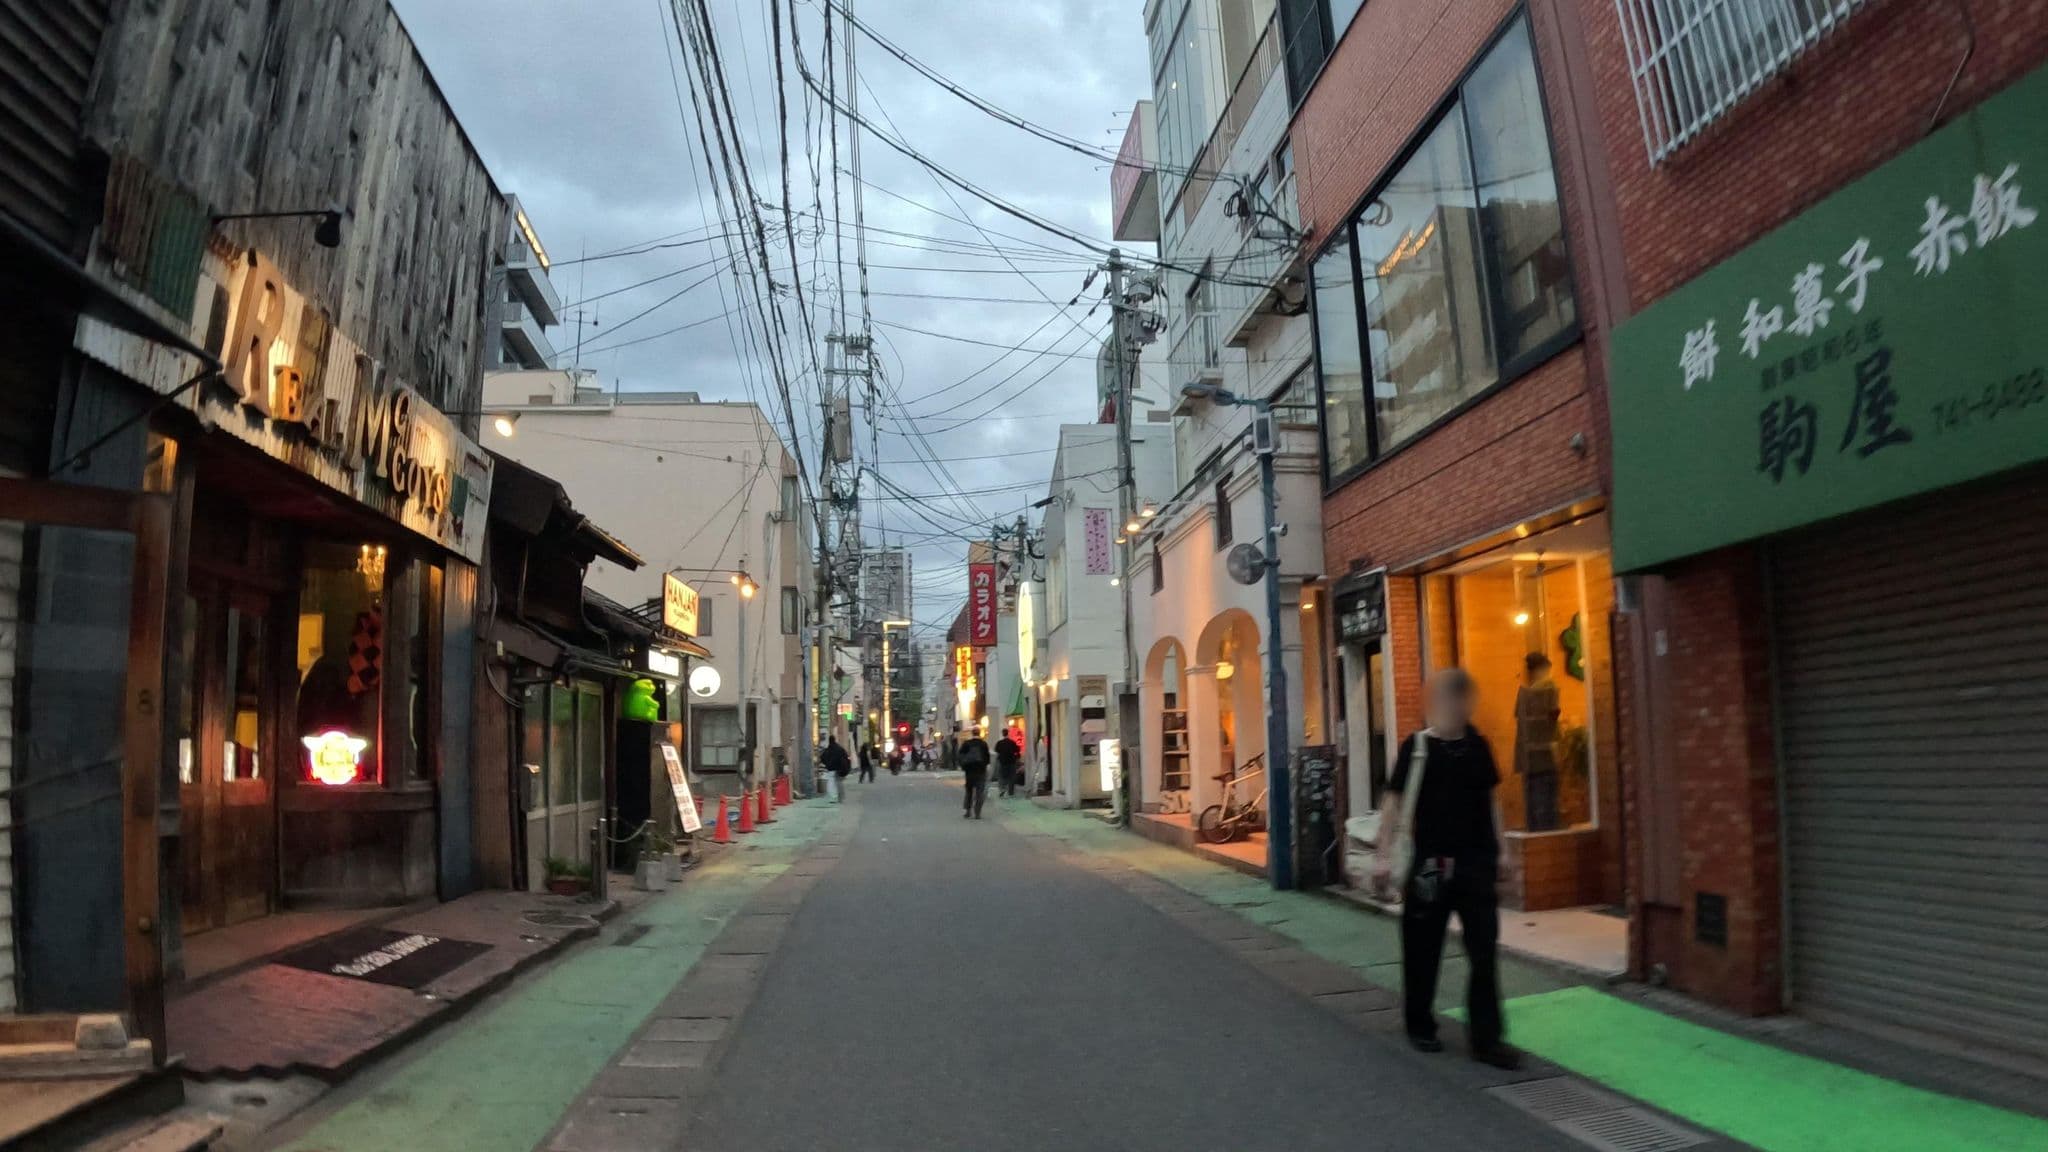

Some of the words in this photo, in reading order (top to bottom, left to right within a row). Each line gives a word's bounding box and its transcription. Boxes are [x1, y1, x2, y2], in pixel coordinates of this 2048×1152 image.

[1679, 318, 1720, 391] 餅
[1739, 236, 1884, 360] 和菓子
[1907, 162, 2039, 278] 赤飯
[1756, 346, 1914, 484] 駒屋
[974, 571, 991, 638] カラオケ
